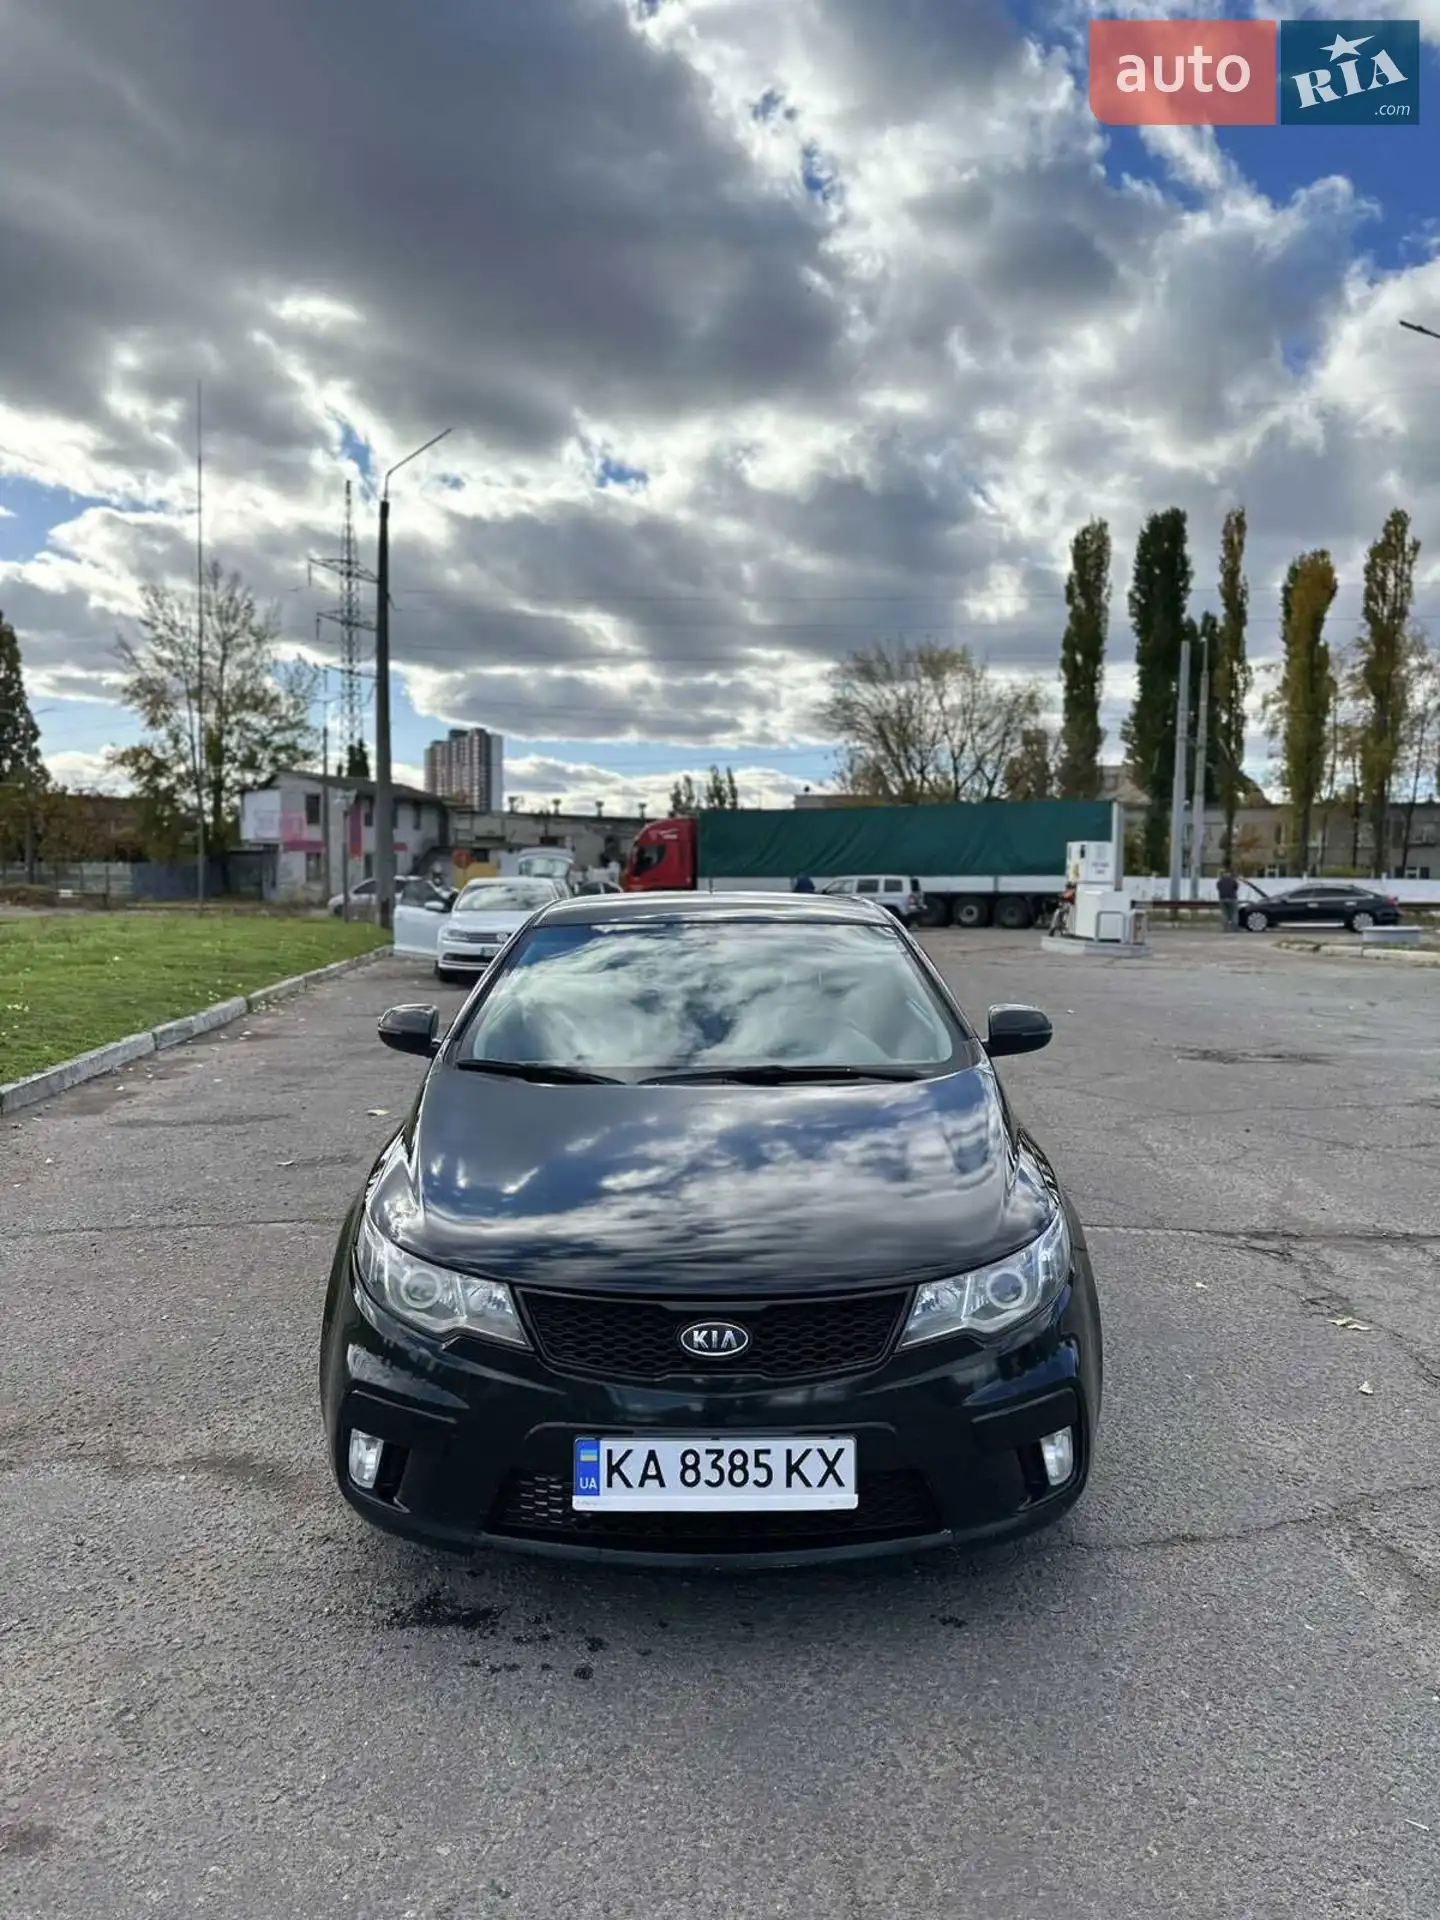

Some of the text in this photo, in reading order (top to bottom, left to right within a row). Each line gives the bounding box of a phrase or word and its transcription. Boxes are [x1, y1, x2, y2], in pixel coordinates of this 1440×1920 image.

[693, 1330, 738, 1349] KIA
[606, 1448, 846, 1488] KA 8385 KX
[579, 1479, 598, 1490] UA
